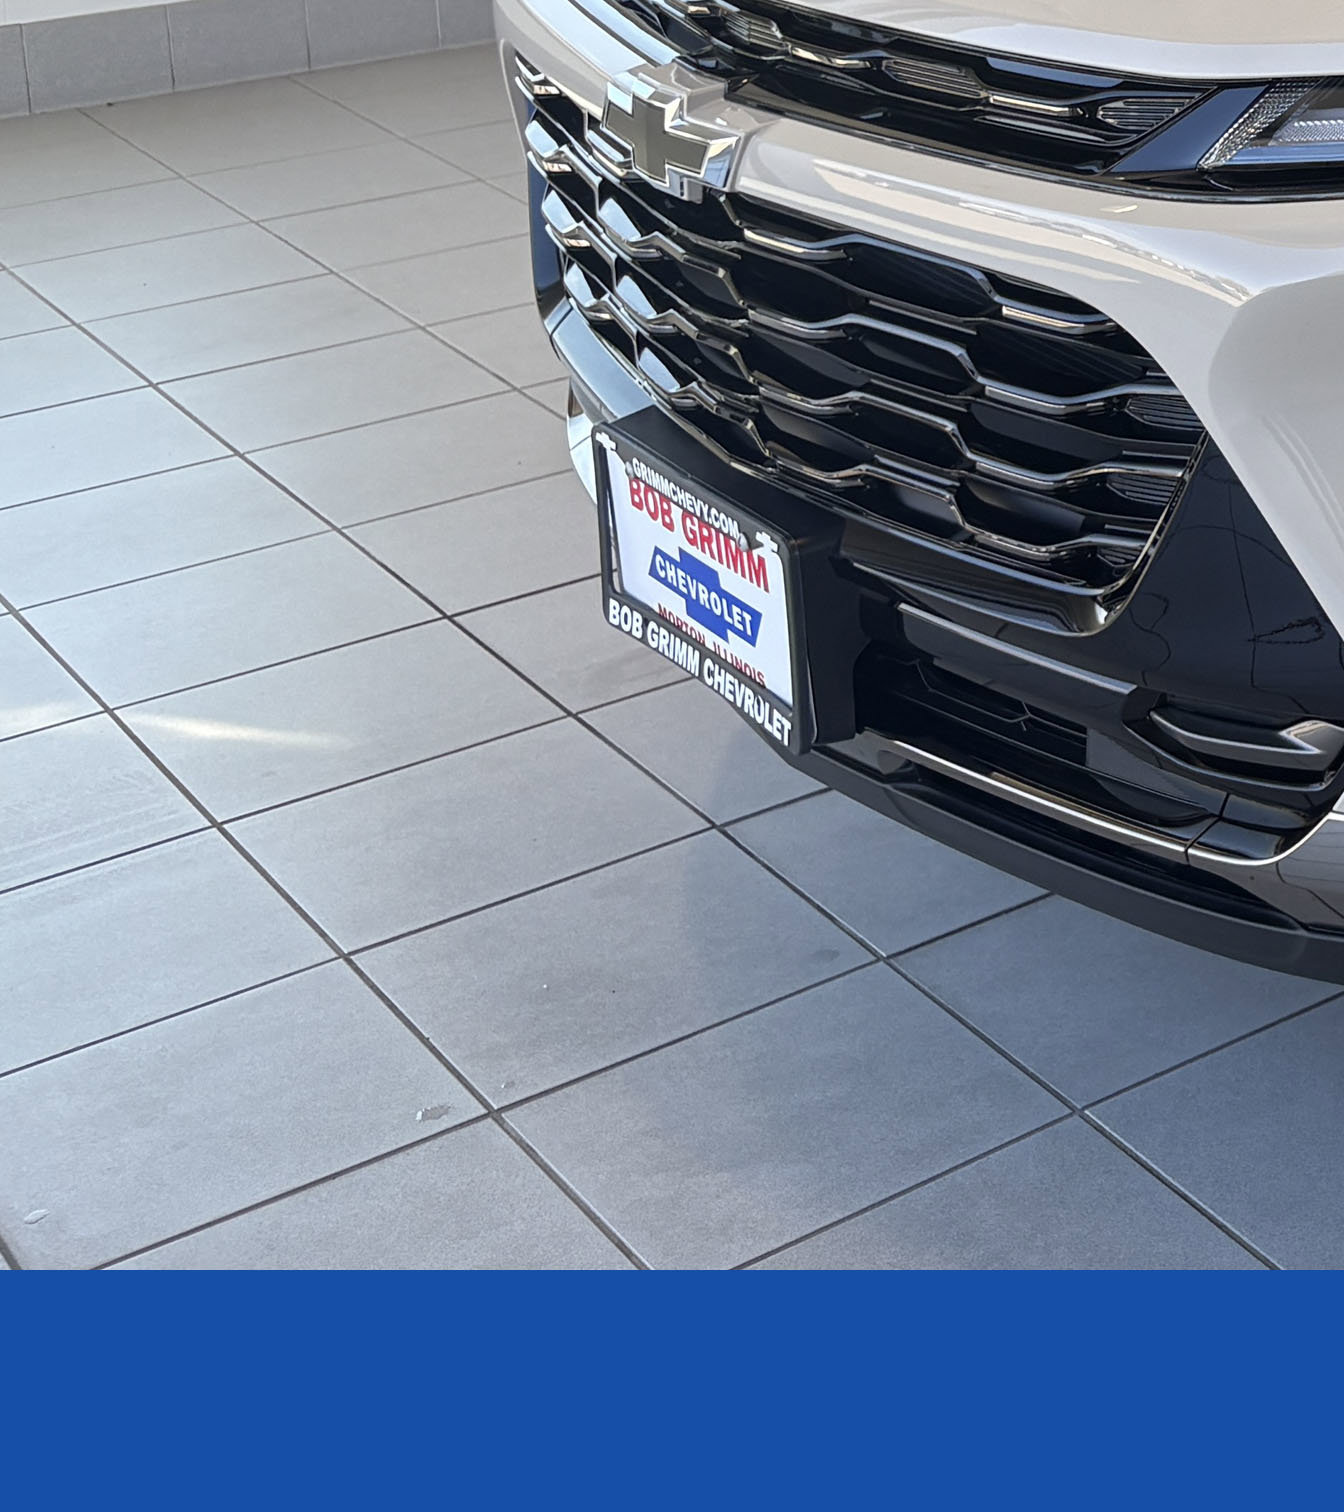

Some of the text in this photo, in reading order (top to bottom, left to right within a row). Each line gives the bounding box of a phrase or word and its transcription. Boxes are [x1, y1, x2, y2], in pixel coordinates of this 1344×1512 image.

[628, 476, 770, 594] BOB GRIMM
[631, 456, 740, 539] GRIMMCHEVY.COM
[655, 553, 752, 637] CHEVROLET
[608, 597, 792, 748] BOB GRIMM CHEVROLET
